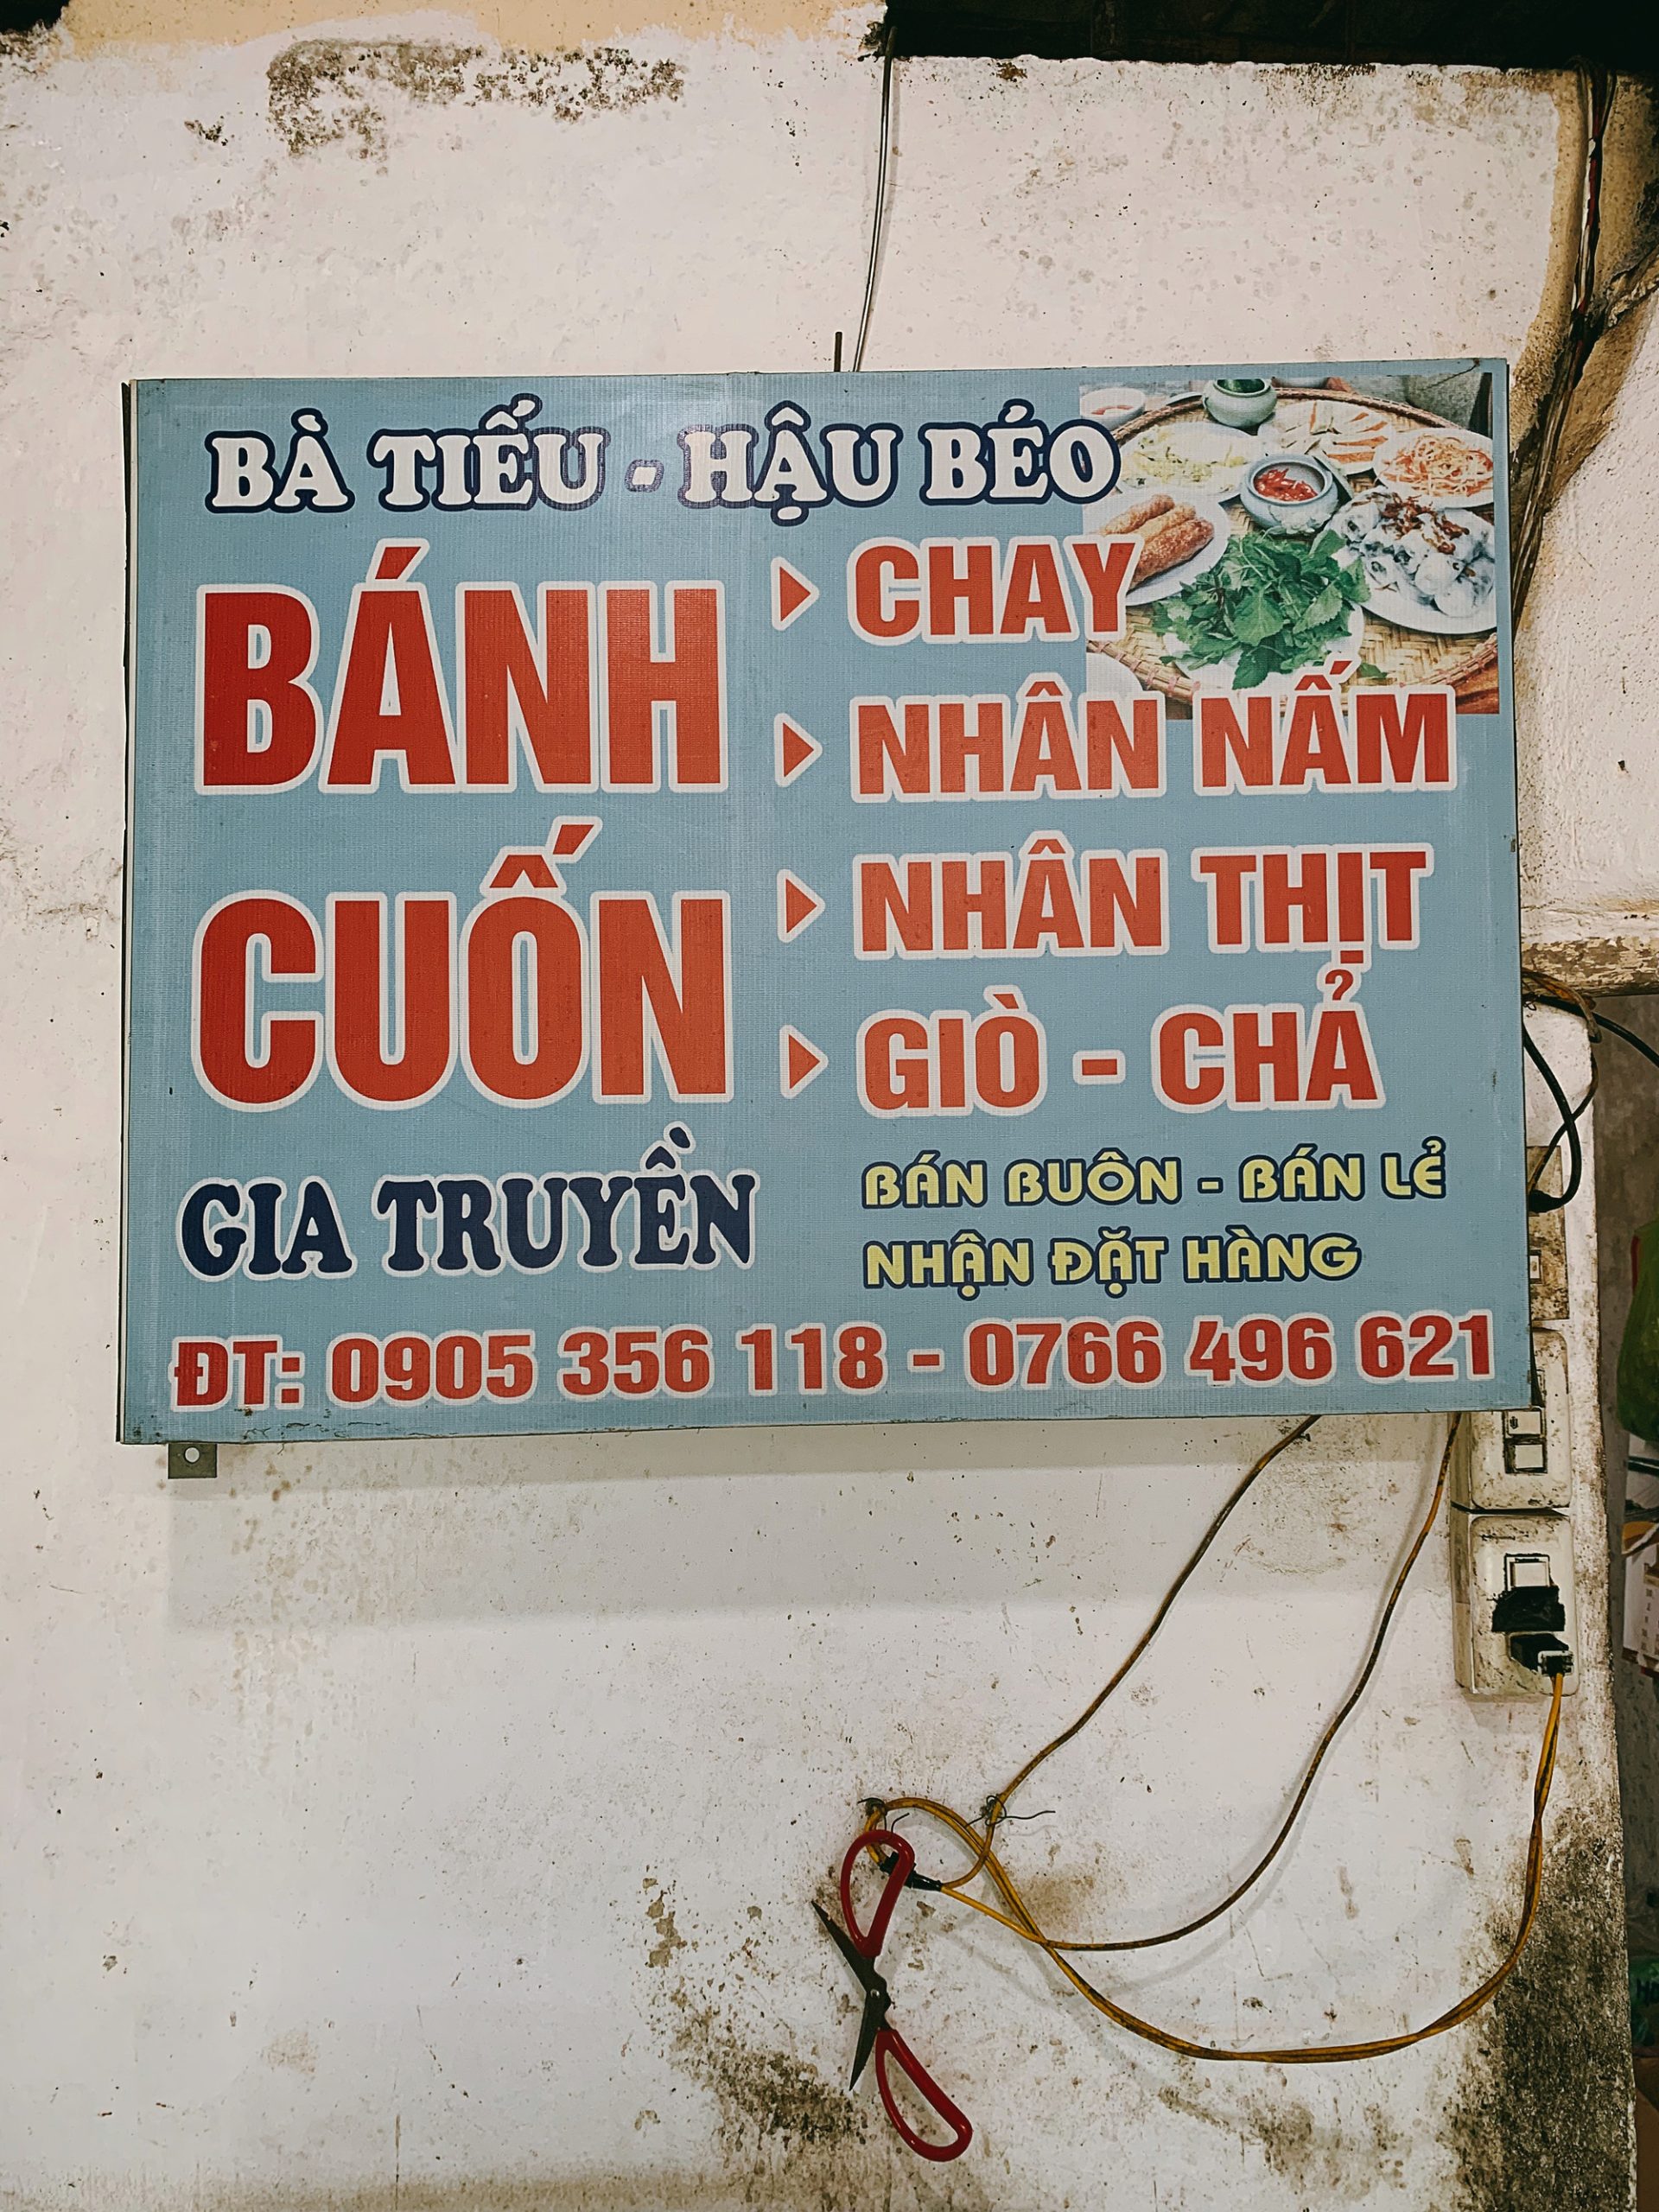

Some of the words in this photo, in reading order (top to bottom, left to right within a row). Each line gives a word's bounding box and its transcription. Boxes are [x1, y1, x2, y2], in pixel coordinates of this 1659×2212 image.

[205, 408, 354, 513] BÀ
[366, 395, 609, 513] TIẾU
[625, 459, 664, 494] -
[678, 401, 899, 525] HẬU
[920, 398, 1122, 505] BÉO
[847, 536, 1143, 645] CHAY
[195, 537, 728, 793] BÁNH
[849, 677, 1166, 803] NHÂN
[1192, 658, 1458, 791] NẤM
[192, 817, 735, 1111] CUỐN
[854, 831, 1168, 957] NHÂN
[1192, 844, 1434, 968] THỊT
[855, 985, 1046, 1116] GIÒ
[1073, 1051, 1125, 1084] -
[1151, 961, 1384, 1110] CHẢ
[177, 1176, 356, 1281] GIA
[372, 1122, 760, 1273] TRUYỀN
[862, 1149, 986, 1209] BÁN
[1005, 1148, 1182, 1205] BUÔN
[1197, 1174, 1221, 1196] -
[1239, 1142, 1364, 1202] BÁN
[1380, 1137, 1447, 1199] LẺ
[862, 1229, 1034, 1301] NHẬN
[1050, 1225, 1168, 1300] ĐẶT
[1182, 1223, 1362, 1284] HÀNG
[171, 1335, 305, 1410] ĐT:
[328, 1332, 537, 1405] 0905
[556, 1327, 714, 1398] 356
[737, 1325, 887, 1395] 118
[906, 1348, 946, 1368] -
[965, 1319, 1166, 1388] 0766
[1185, 1319, 1335, 1384] 496
[1357, 1313, 1493, 1380] 621
